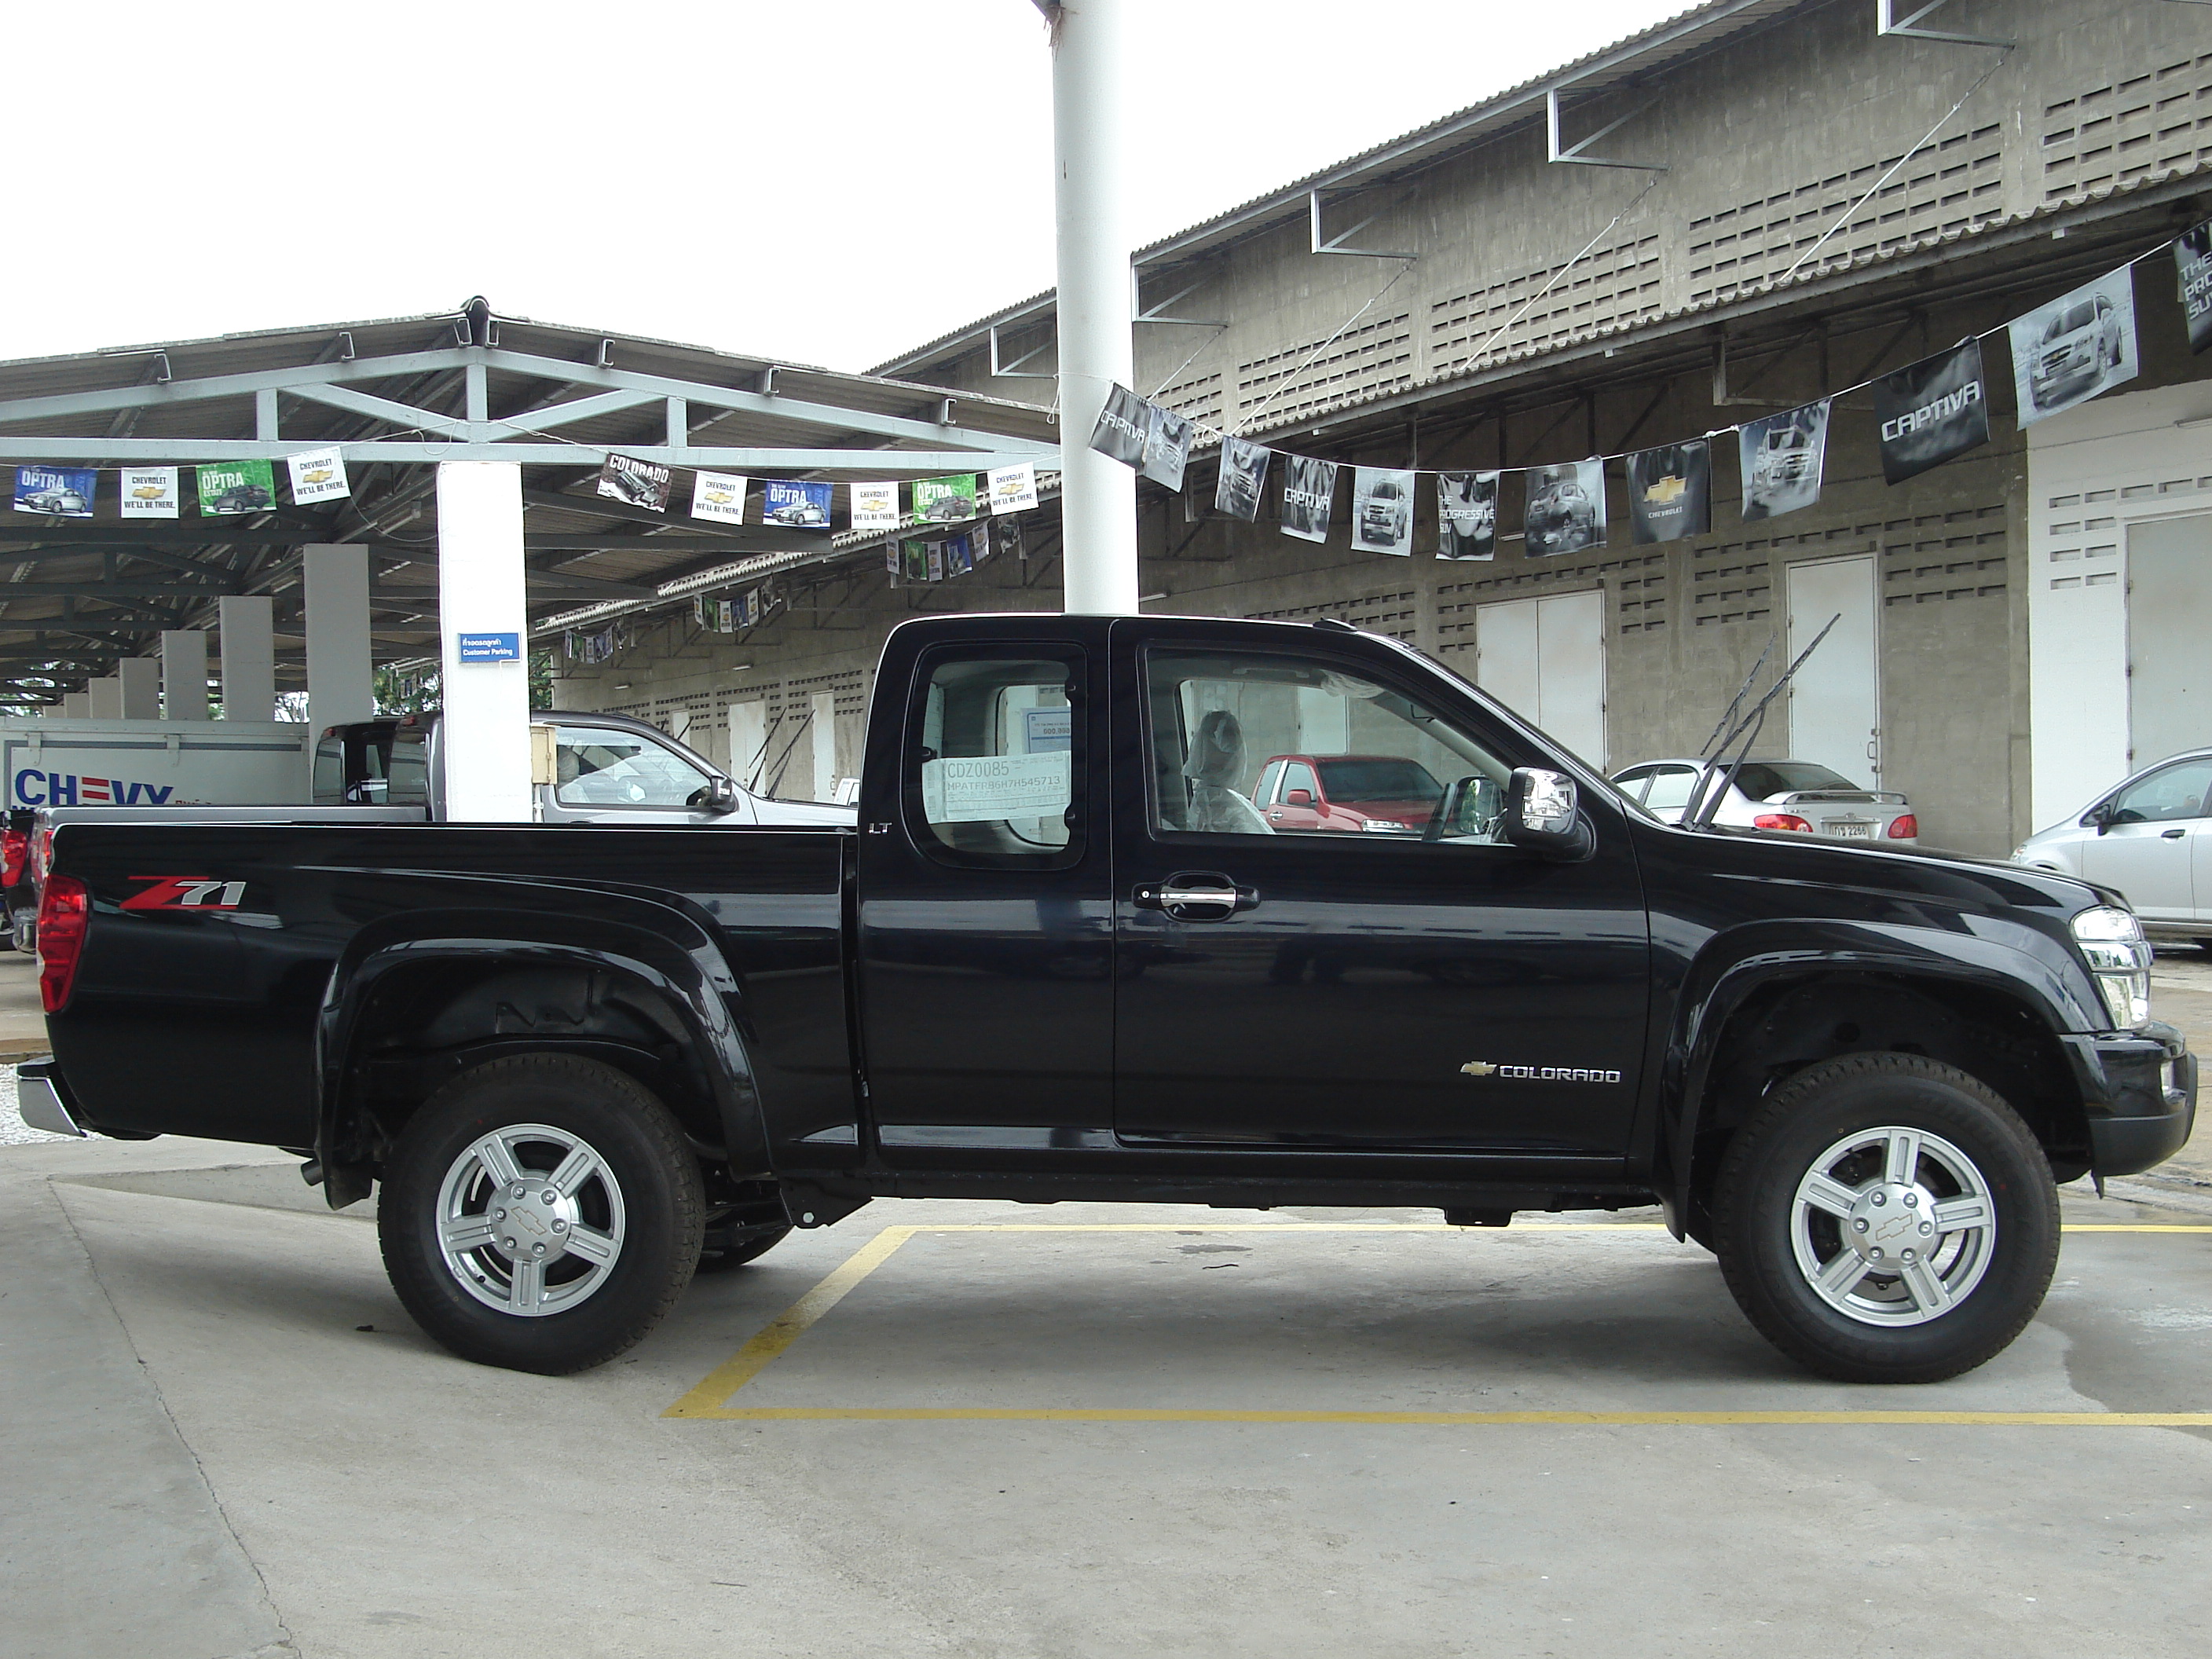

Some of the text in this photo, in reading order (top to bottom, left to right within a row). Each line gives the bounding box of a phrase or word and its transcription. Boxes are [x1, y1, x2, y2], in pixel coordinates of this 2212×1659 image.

[2180, 251, 2212, 281] THE
[1881, 380, 1981, 441] CAPTIVA
[1100, 410, 1145, 444] CAPTIVA
[299, 458, 332, 470] CHEVROLET
[610, 454, 670, 483] COLORADO
[21, 471, 65, 489] OPTRA
[203, 472, 244, 489] OPTRA
[296, 485, 315, 496] WE'LL
[326, 480, 346, 491] THERE.
[770, 488, 807, 504] OPTRA
[917, 484, 952, 499] OPTRA
[1284, 487, 1330, 511] CAPTIVA
[1438, 495, 1453, 505] THE
[124, 500, 143, 509] WE'LL
[947, 761, 1009, 778] CDZ0085
[15, 768, 174, 805] CHEVY
[869, 822, 892, 834] LT
[119, 876, 247, 910] Z71
[1500, 1065, 1621, 1083] COLORADO
